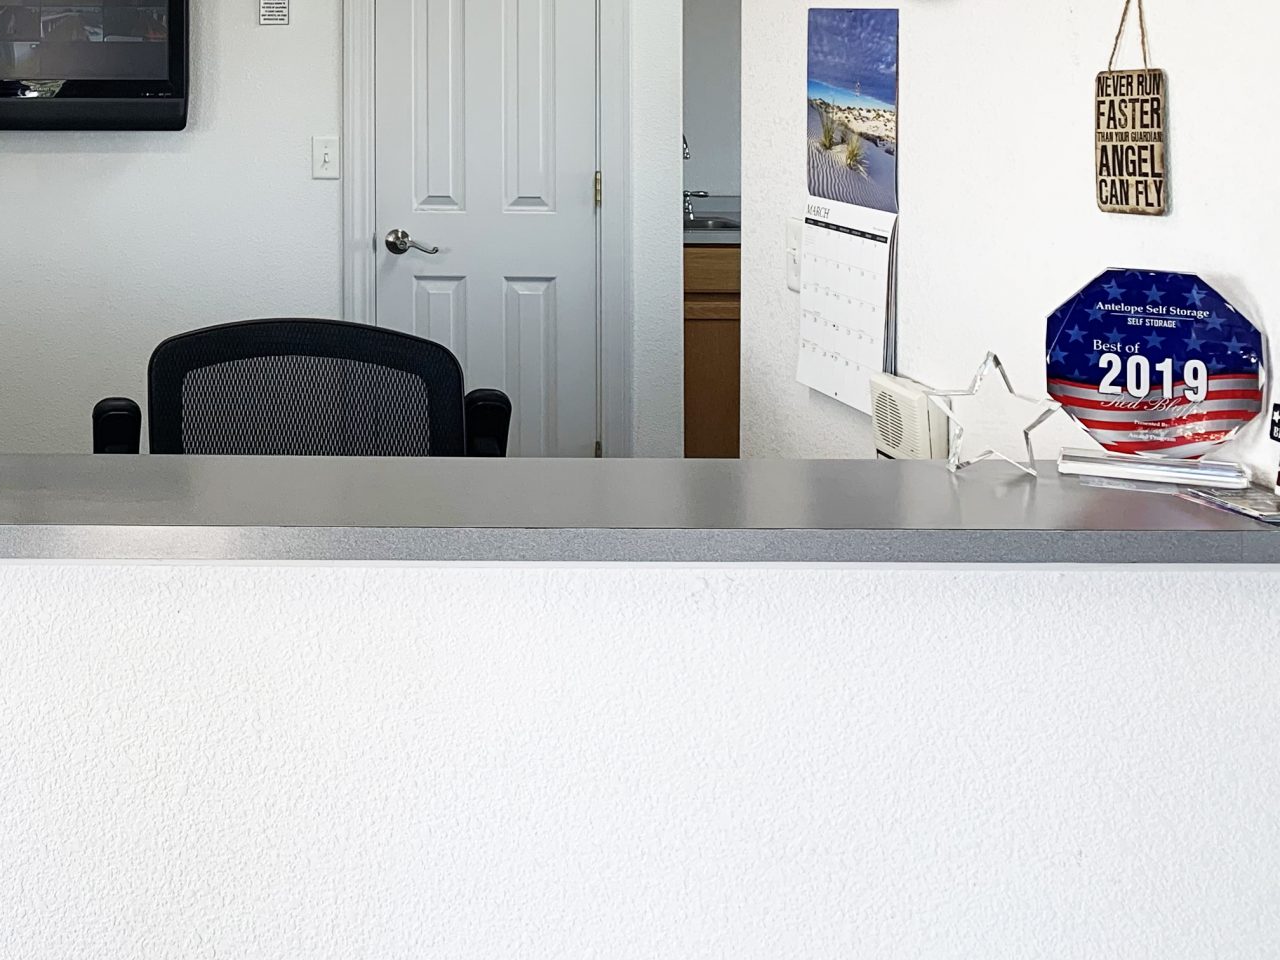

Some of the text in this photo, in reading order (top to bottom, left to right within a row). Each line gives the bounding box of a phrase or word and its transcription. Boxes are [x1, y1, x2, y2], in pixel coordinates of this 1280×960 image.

[1097, 73, 1161, 97] NEVER RUN
[1096, 97, 1161, 129] FASTER
[1097, 131, 1163, 143] THAN YOUR GUARDIAN
[1098, 144, 1163, 178] ANGEL
[1099, 178, 1163, 207] CAN FLY
[807, 204, 830, 219] MARCH
[1096, 301, 1210, 319] Antelope Self Storage
[1127, 317, 1176, 328] SELF STORAGE
[1093, 339, 1140, 354] Best of
[1098, 352, 1209, 403] 2019
[1100, 394, 1200, 419] Red Bluff
